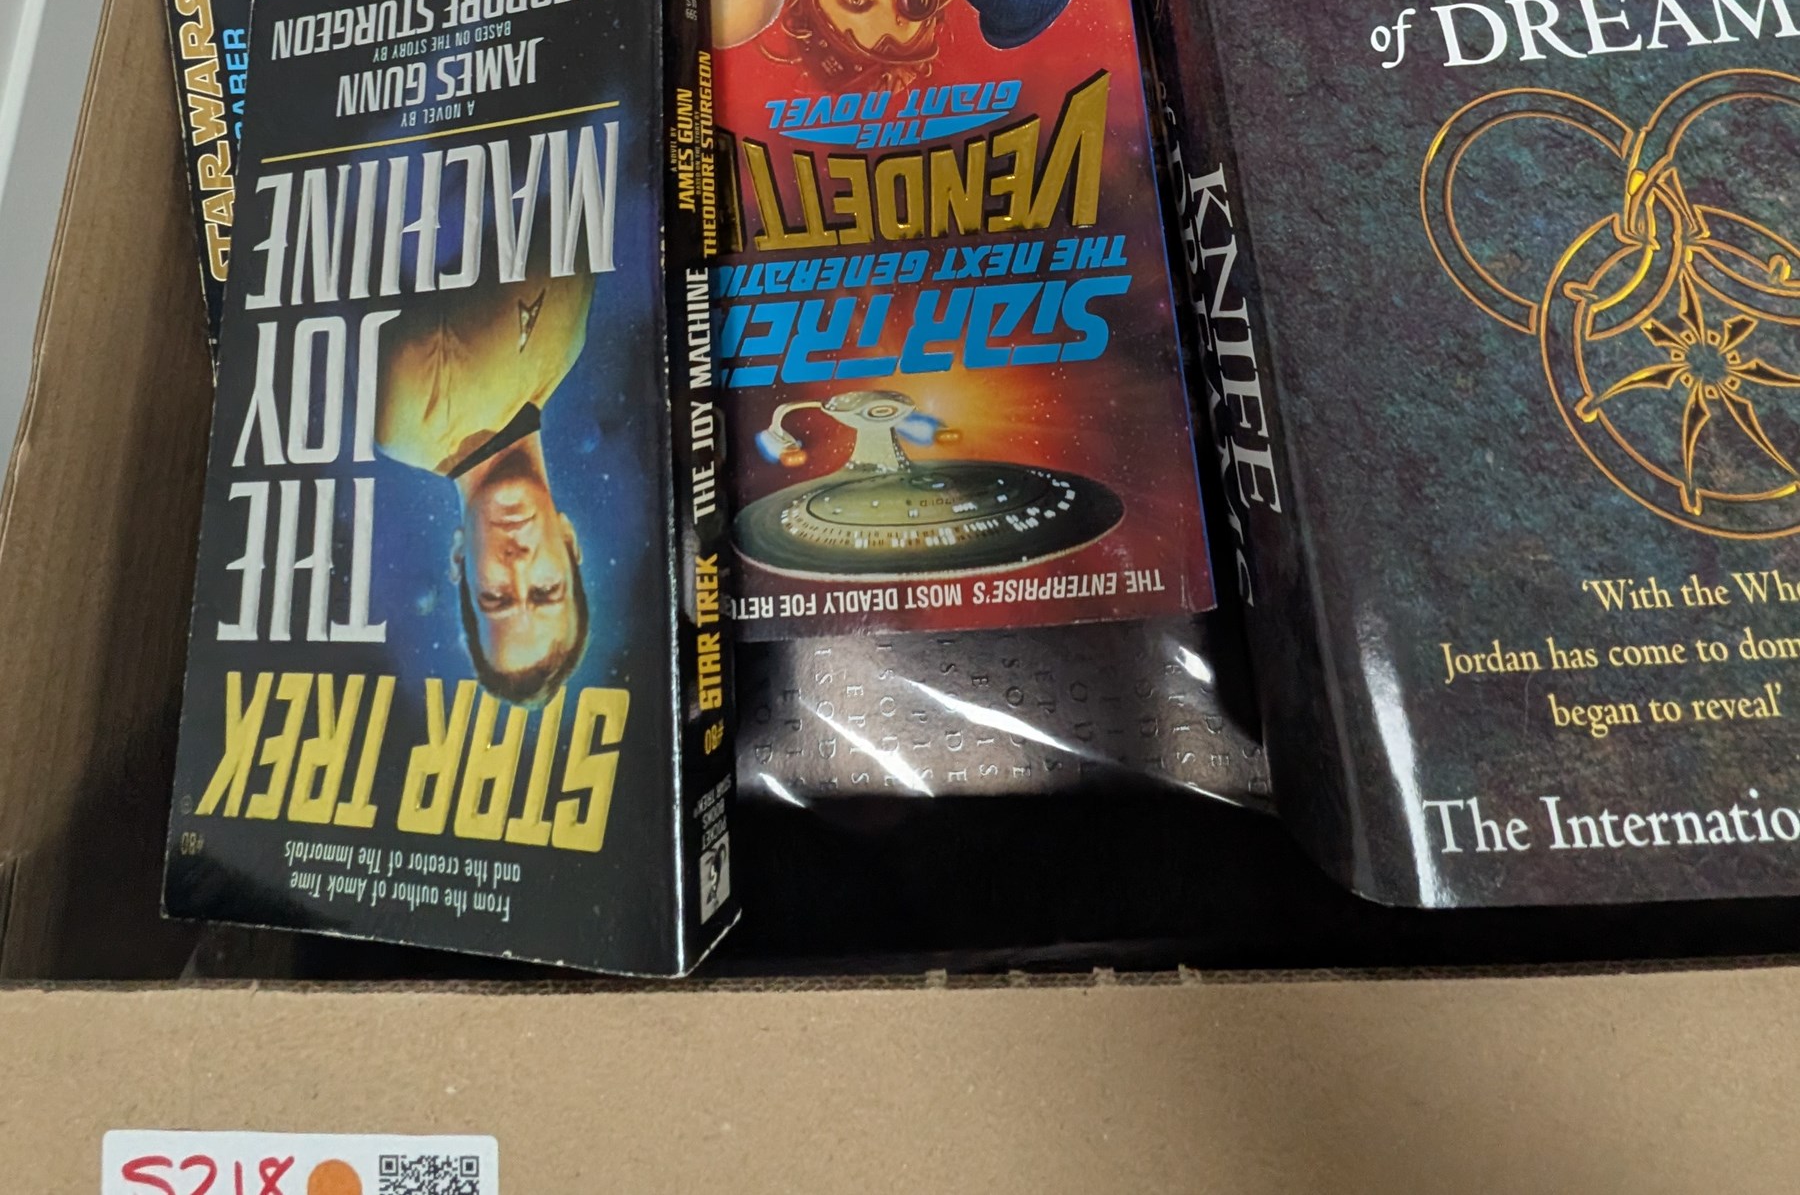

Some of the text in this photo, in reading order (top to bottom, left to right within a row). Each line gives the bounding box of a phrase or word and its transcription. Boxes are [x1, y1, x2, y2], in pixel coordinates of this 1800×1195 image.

[372, 20, 512, 63] BASED ON THE STORY BY
[1370, 6, 1417, 69] of
[336, 36, 545, 118] JAMES GUNN
[765, 80, 1022, 130] GIANT NOVEL
[400, 99, 476, 128] A NOVEL BY
[856, 117, 930, 149] THE
[676, 88, 696, 213] JAMES GUNN
[698, 50, 717, 259] THEODORE STURGEON
[244, 121, 620, 311] MACHINE
[932, 240, 1045, 281] NEXT
[1050, 234, 1128, 272] THE
[899, 275, 1132, 375] STAR
[1187, 162, 1283, 514] KNIFE
[231, 308, 402, 468] JOY
[686, 267, 716, 525] THE JOY MACHINE
[216, 477, 387, 643] THE
[779, 568, 1166, 617] THE ENTERPRISE'S MOST DEADLY FOE
[1680, 574, 1730, 607] the
[694, 553, 723, 713] STAR TREK
[1440, 638, 1542, 684] Jordan
[1545, 636, 1599, 671] has
[1607, 642, 1686, 668] come
[1696, 637, 1729, 663] to
[1547, 693, 1641, 739] began
[1650, 699, 1682, 723] to
[194, 671, 397, 829] TREK
[396, 678, 630, 854] STAR
[1421, 787, 1800, 854] The Internatio
[284, 839, 521, 889] and the creator of The Immortals
[290, 870, 511, 923] From the author of Amok Time
